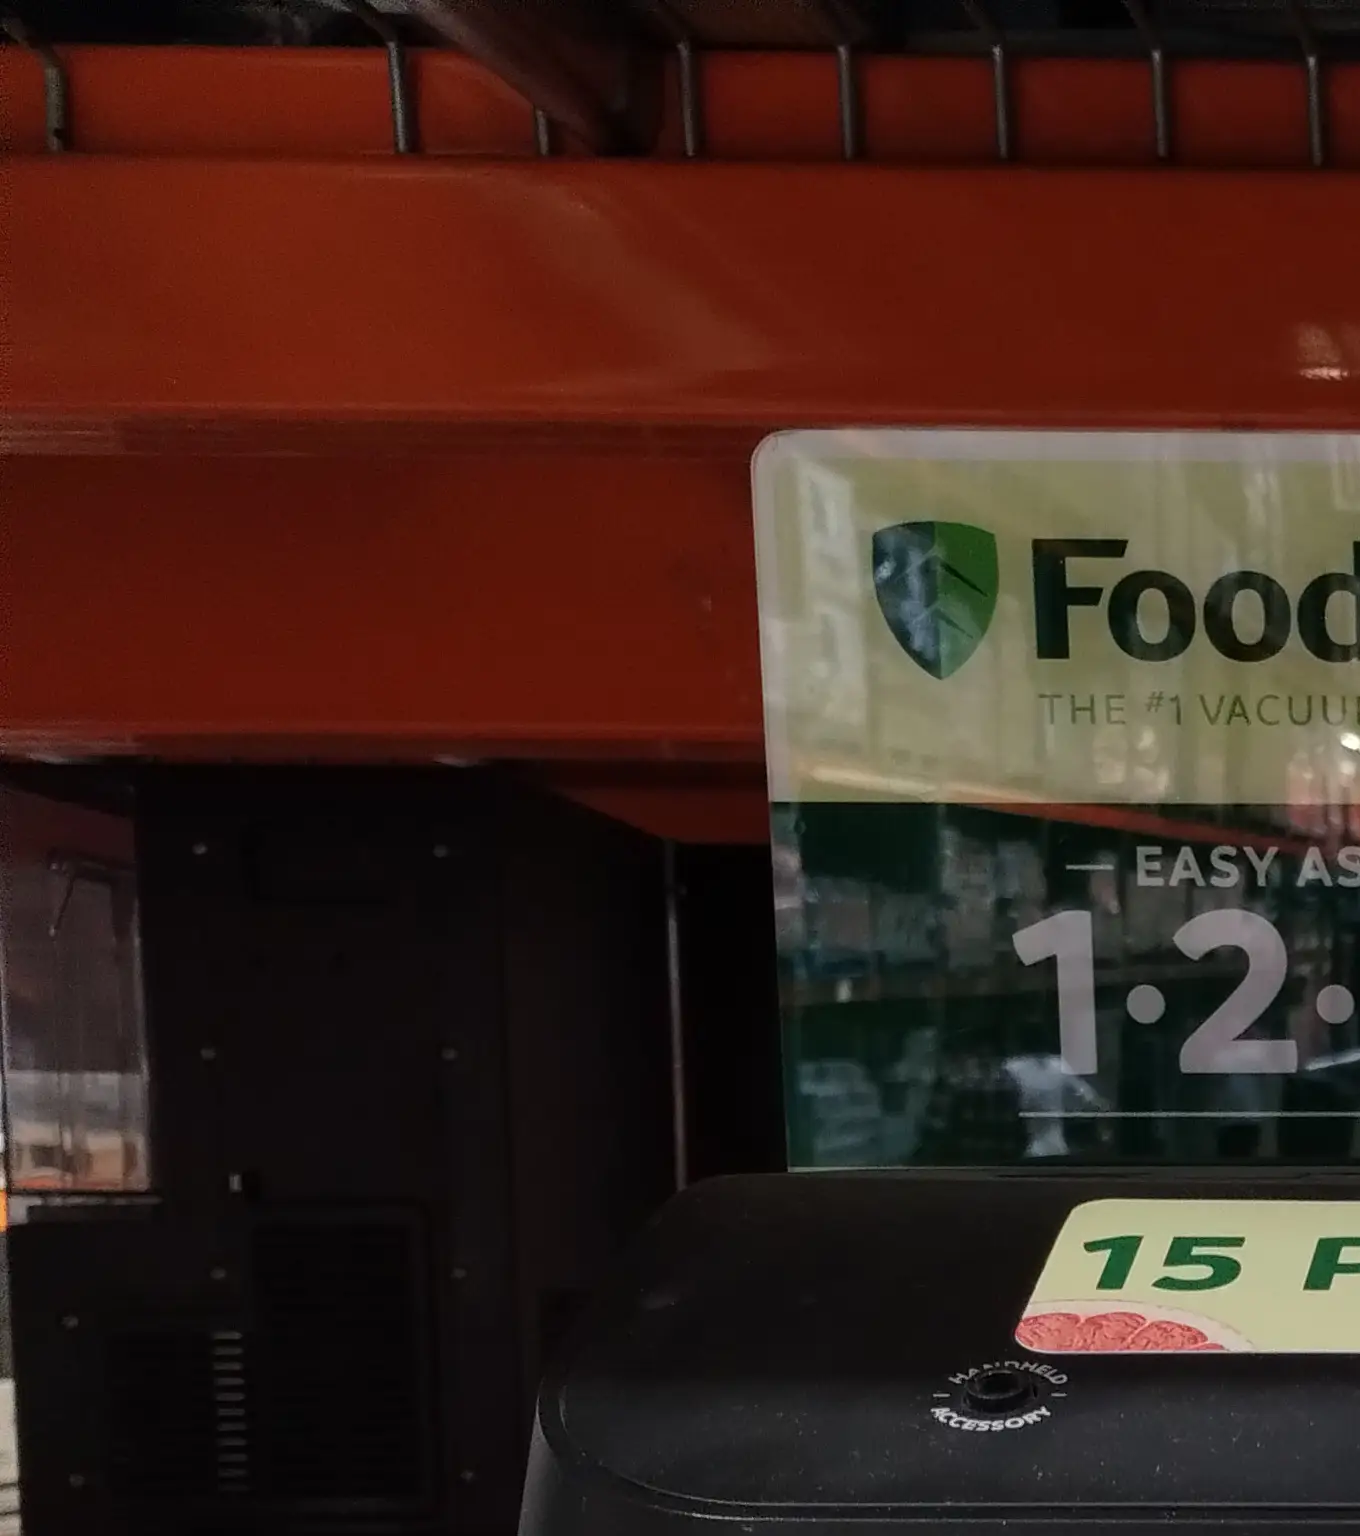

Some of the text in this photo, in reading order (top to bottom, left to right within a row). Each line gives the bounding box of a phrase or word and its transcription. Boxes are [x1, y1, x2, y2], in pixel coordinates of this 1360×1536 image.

[1038, 693, 1127, 727] THE
[1145, 691, 1184, 727] #1
[1135, 845, 1280, 889] EASY
[1082, 1234, 1247, 1293] 15
[929, 1405, 1052, 1433] ACCESSORY
